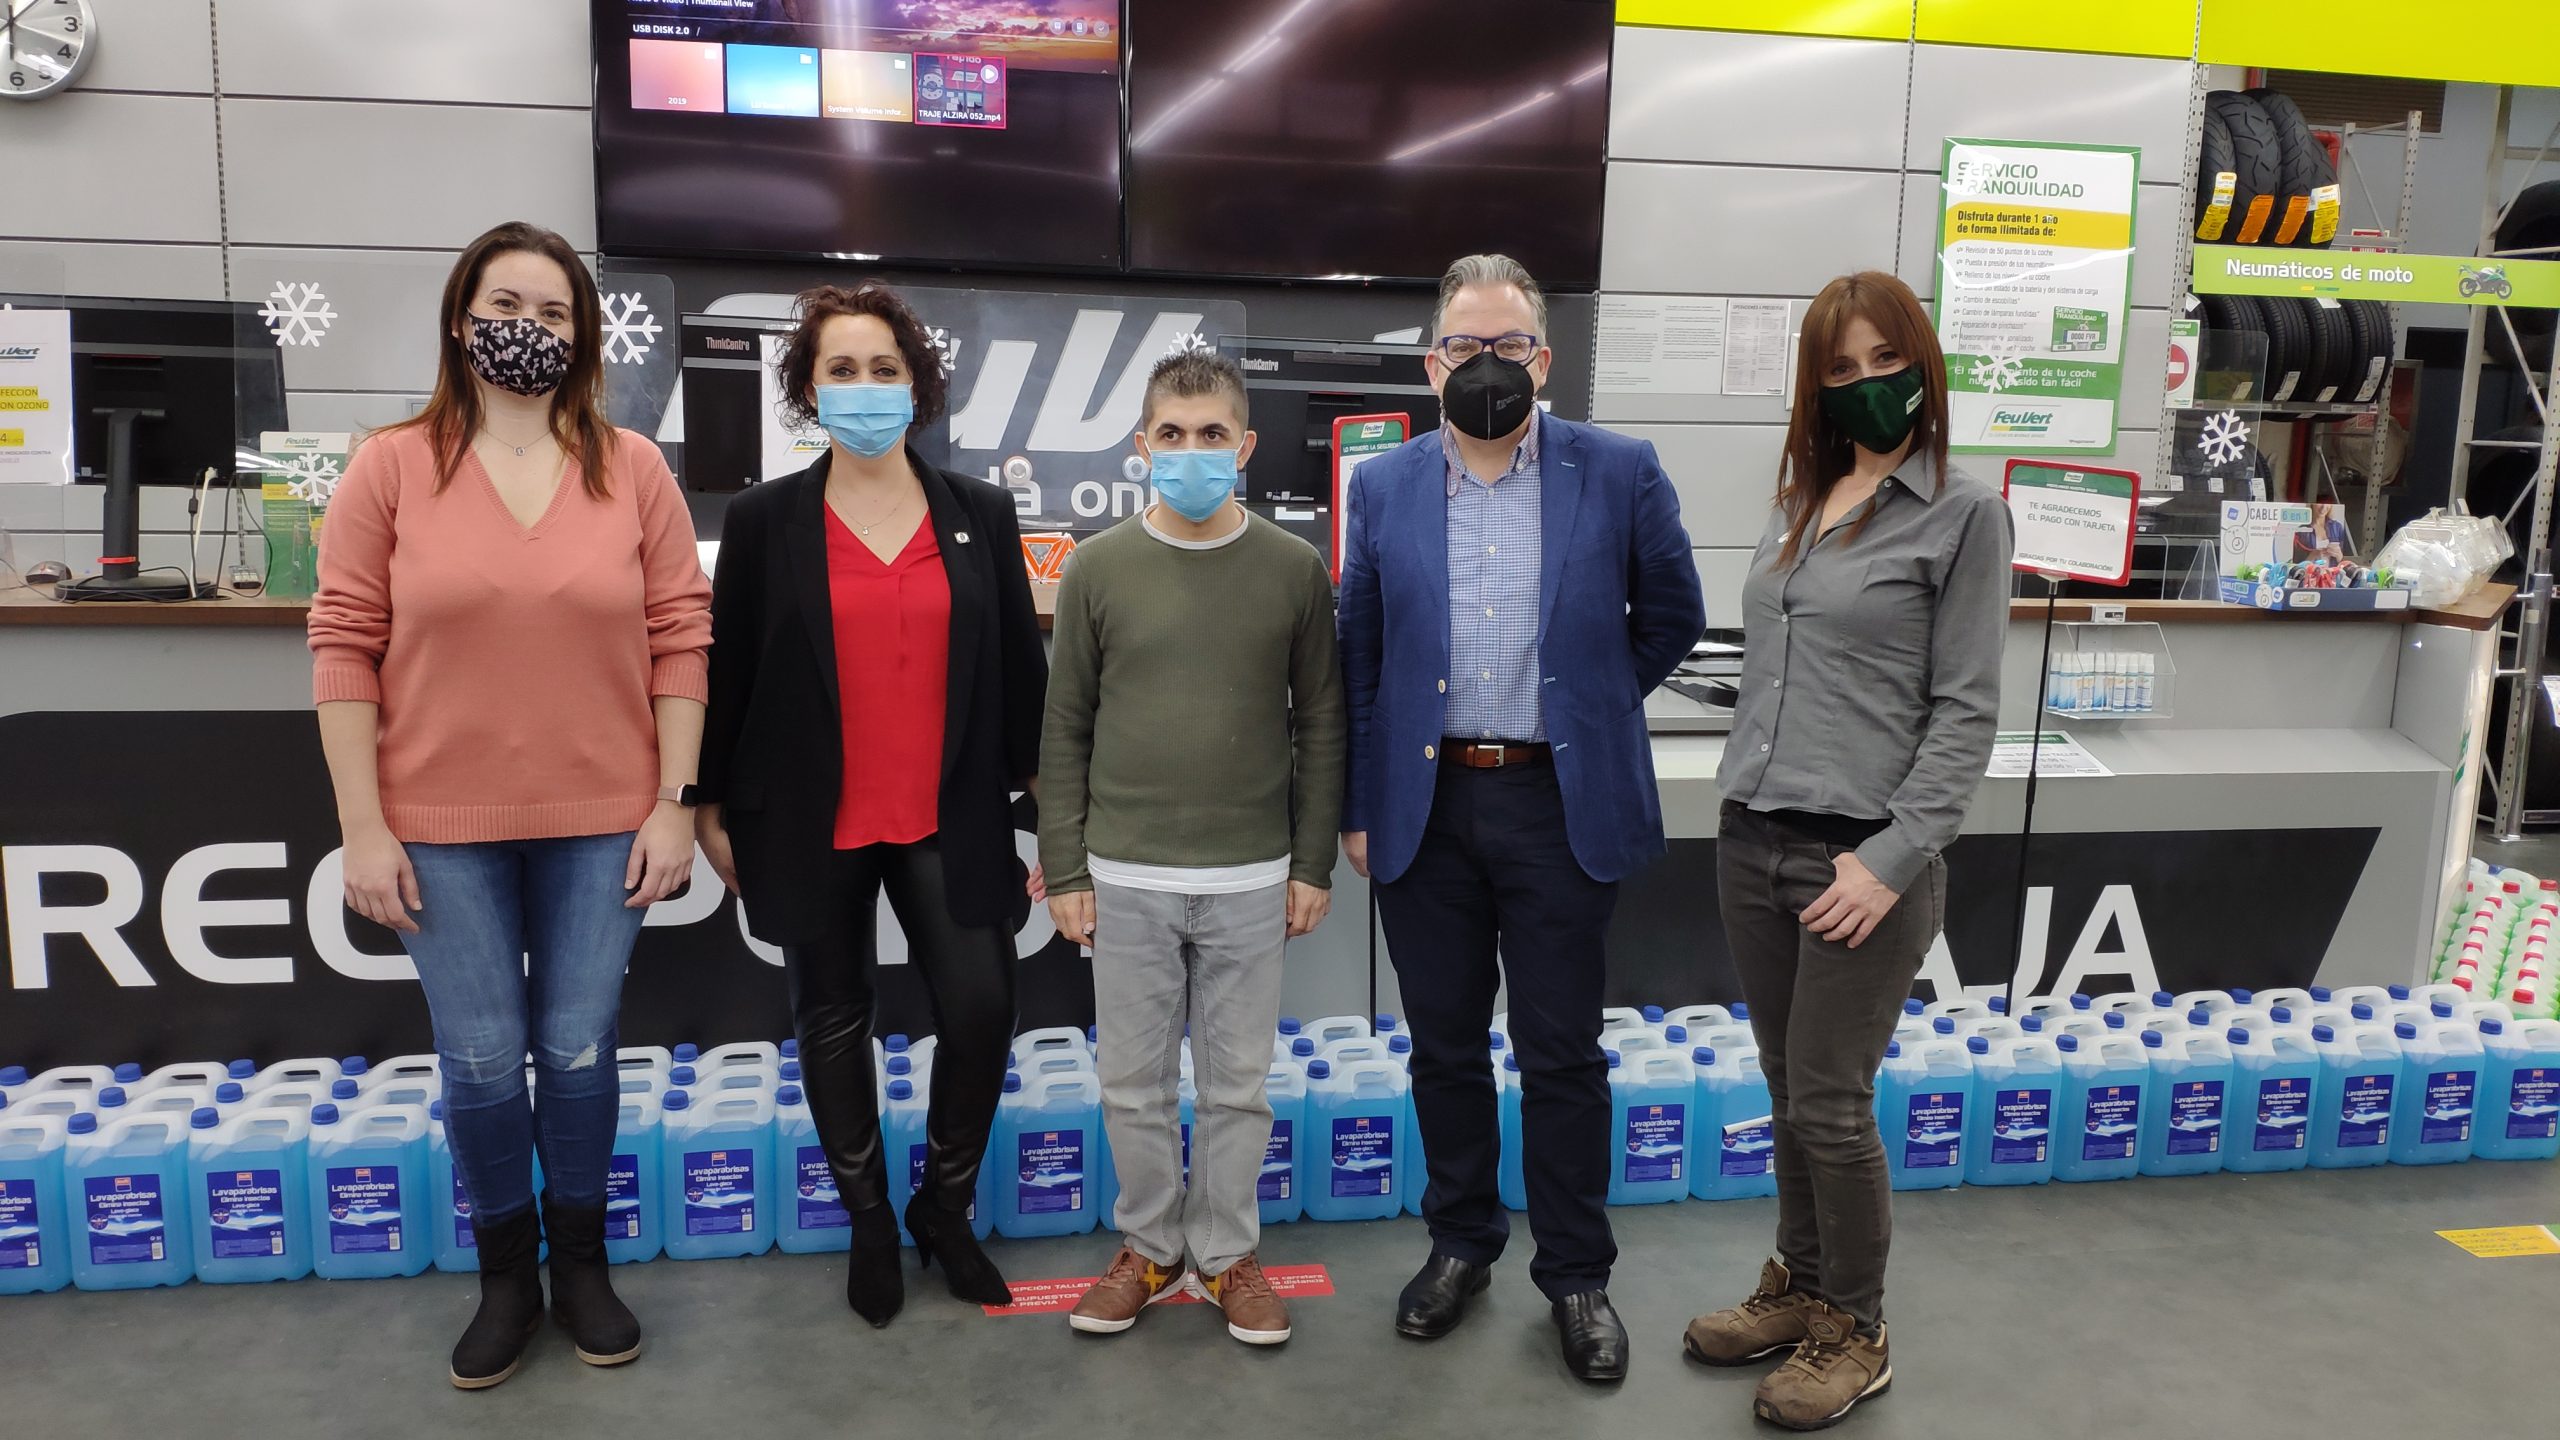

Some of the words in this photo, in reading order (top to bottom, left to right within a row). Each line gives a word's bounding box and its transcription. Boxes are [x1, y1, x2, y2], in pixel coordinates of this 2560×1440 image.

[64, 17, 78, 32] 3
[632, 24, 650, 33] USB
[653, 25, 674, 34] DISK
[675, 26, 690, 35] 2.0
[57, 44, 71, 58] 4
[10, 71, 25, 86] 6
[668, 97, 687, 105] 2019
[918, 109, 941, 118] TRAJE
[943, 110, 968, 119] ALZIRA
[970, 112, 1001, 122] 052.mp4
[1957, 210, 1994, 222] Disfruta
[1997, 212, 2031, 224] durante
[2034, 214, 2039, 223] 1
[1957, 223, 1968, 233] de
[1971, 224, 1997, 234] forma
[2042, 227, 2056, 237] de:
[1989, 247, 1996, 255] de
[1997, 247, 2004, 255] 50
[2038, 249, 2053, 257] coche
[2226, 258, 2334, 280] Neumáticos
[2341, 264, 2362, 281] de
[2368, 266, 2414, 284] moto
[705, 336, 750, 351] ThinkCentre
[1240, 358, 1279, 371] ThinkCentre
[2042, 368, 2053, 377] de
[2057, 368, 2066, 378] tu
[2070, 369, 2097, 379] coche
[2041, 379, 2057, 388] tan
[2061, 378, 2081, 388] fácil
[17, 401, 49, 410] OZONO
[2029, 501, 2038, 510] TE
[2041, 503, 2102, 518] AGRADECEMOS
[2250, 508, 2278, 520] CABLE
[2027, 513, 2037, 521] EL
[2040, 514, 2062, 524] PAGO
[2064, 518, 2080, 527] CON
[2083, 520, 2116, 532] TARJETA
[1630, 1119, 1681, 1128] Lavaparabrisas
[1336, 1131, 1389, 1141] Lavaparabrisas
[1022, 1145, 1079, 1156] Lavaparabrisas
[1029, 1154, 1048, 1162] Elimina
[688, 1165, 749, 1176] Lavaparabrisas
[212, 1186, 277, 1197] Lavaparabrisas
[332, 1183, 395, 1193] Lavaparabrisas
[90, 1191, 157, 1203] Lavaparabrisas
[99, 1201, 122, 1209] Elimina
[1054, 1282, 1091, 1290] TALLER
[1020, 1300, 1059, 1308] PREVIA
